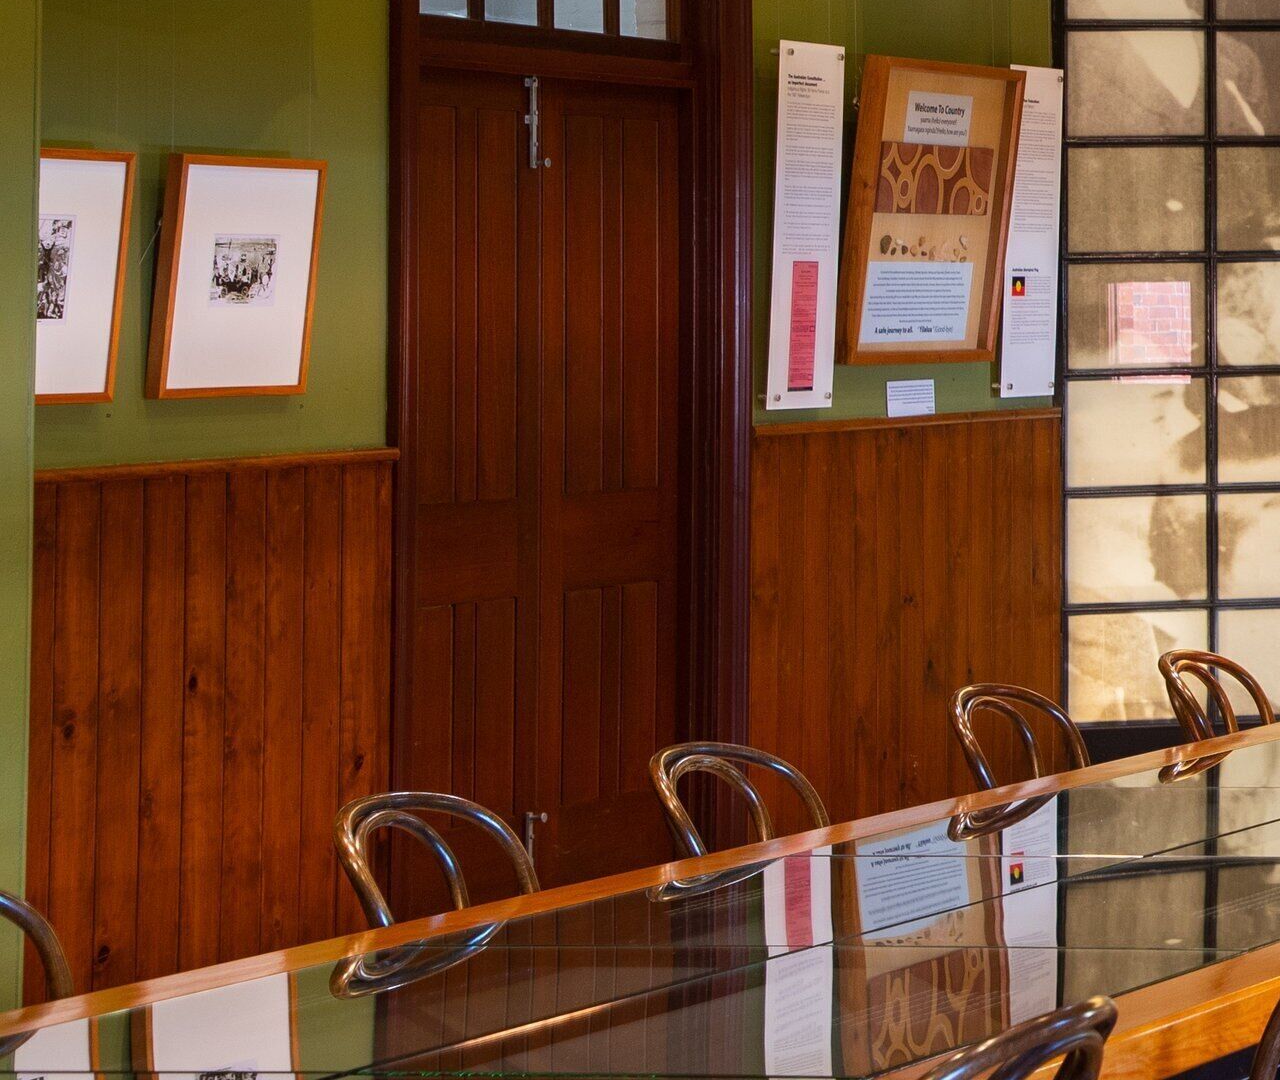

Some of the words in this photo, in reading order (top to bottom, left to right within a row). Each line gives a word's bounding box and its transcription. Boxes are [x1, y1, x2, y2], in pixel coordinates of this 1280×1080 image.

[915, 102, 937, 113] Welcome
[938, 105, 944, 114] To
[945, 106, 965, 117] Country
